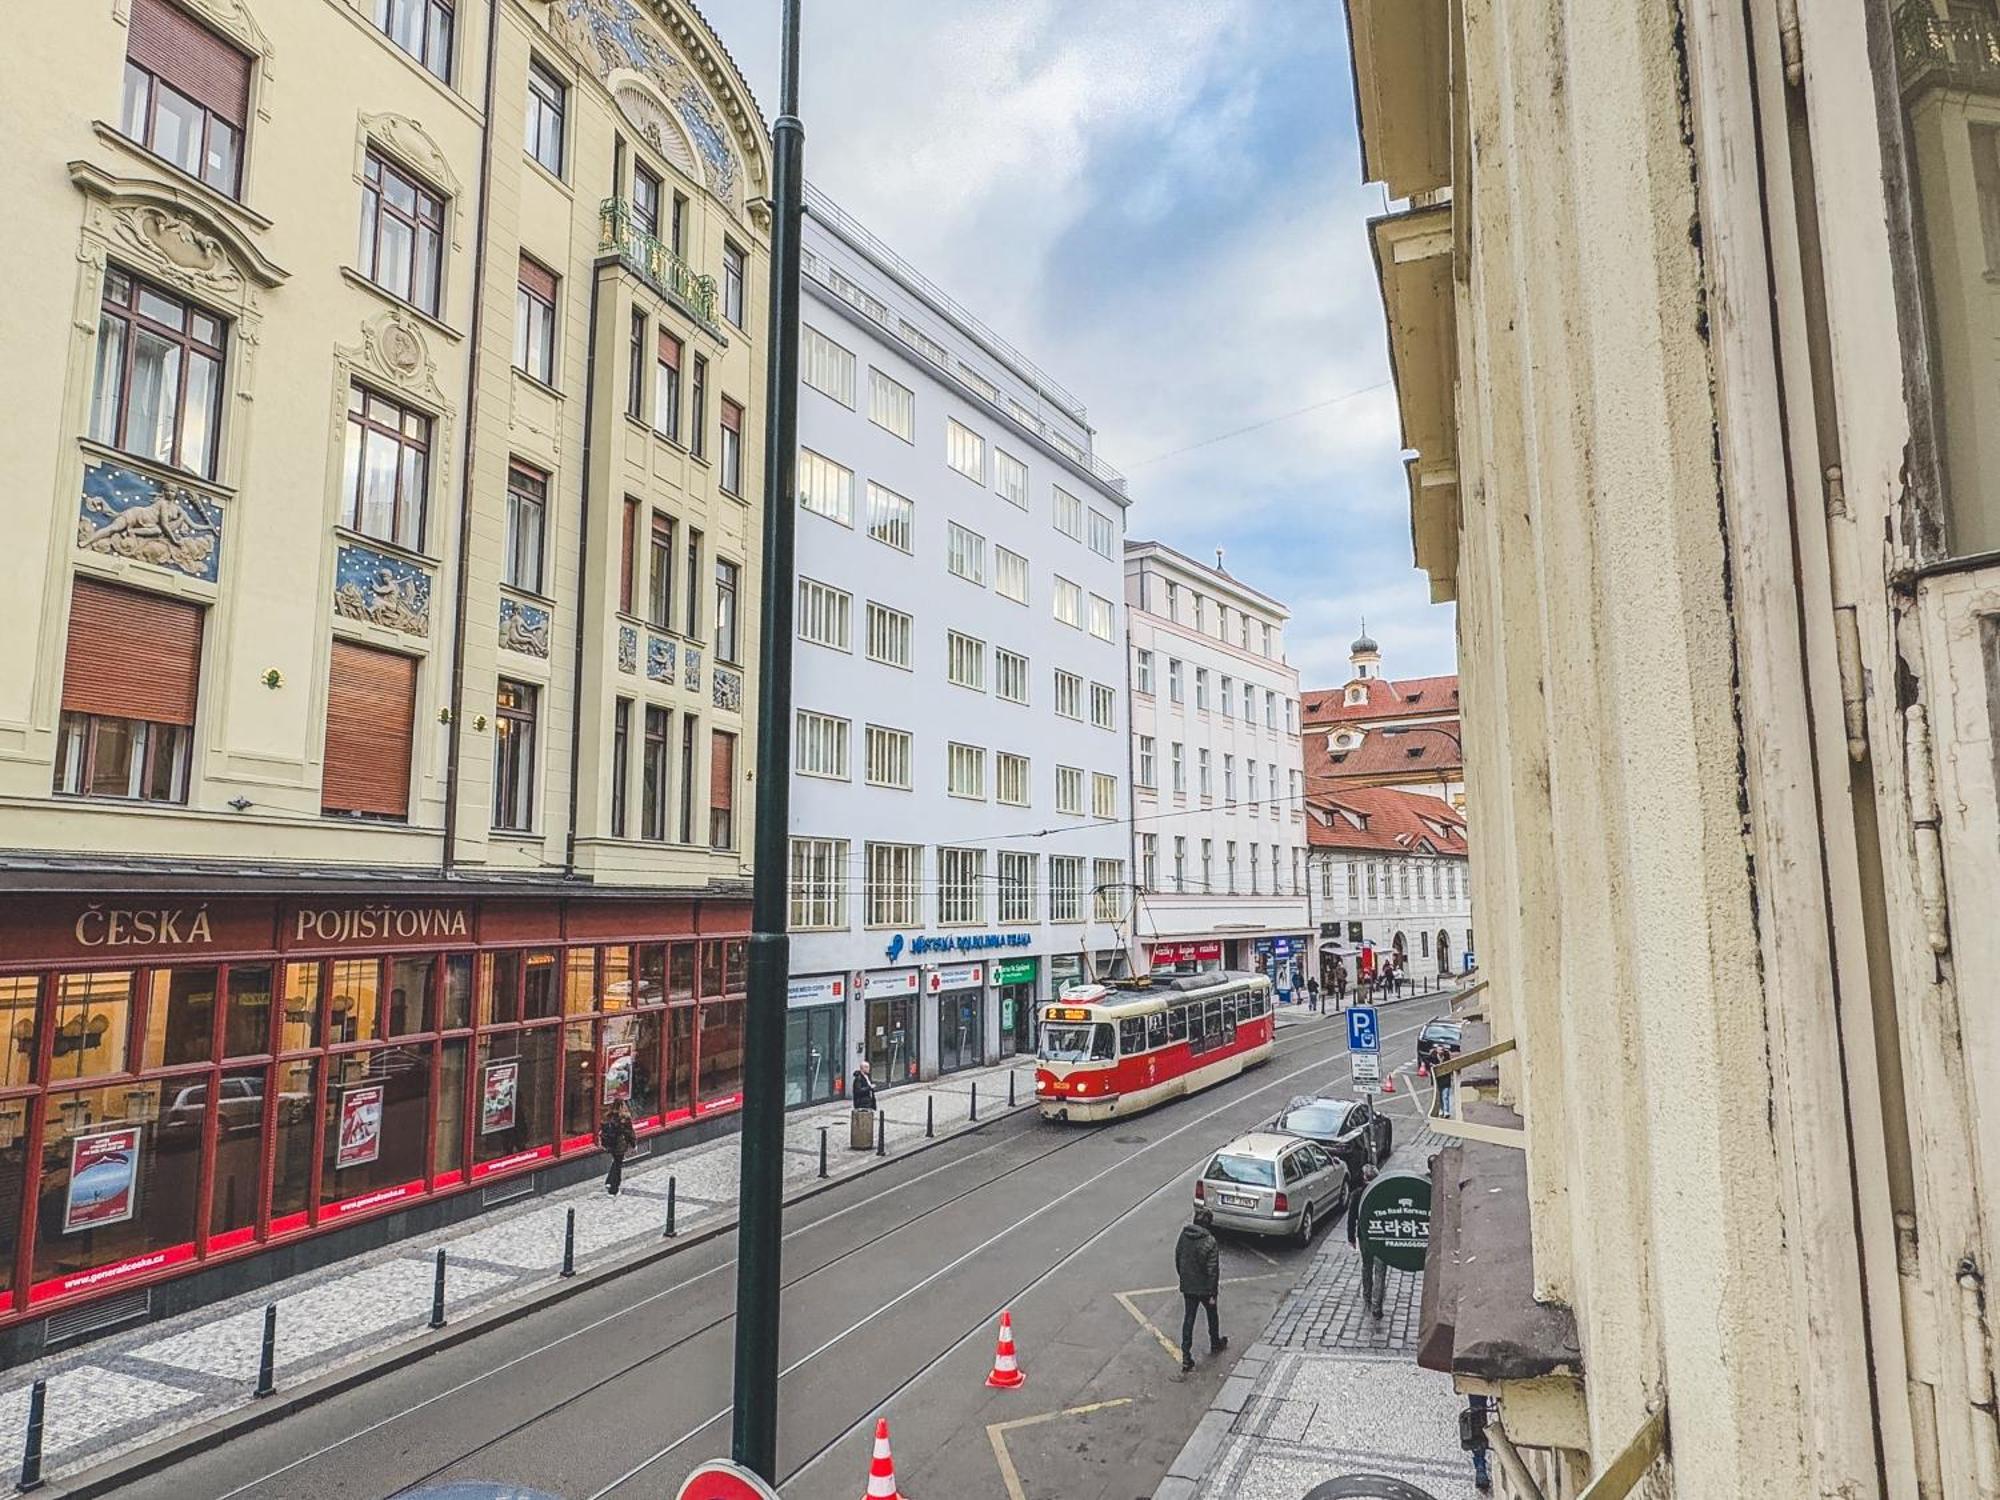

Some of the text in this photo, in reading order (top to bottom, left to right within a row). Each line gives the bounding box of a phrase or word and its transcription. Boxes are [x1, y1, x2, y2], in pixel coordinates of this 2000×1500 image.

[75, 902, 467, 946] ČESKÁ POJIŠŤOVNA
[1049, 1008, 1057, 1018] 2
[1353, 1013, 1370, 1037] P
[1403, 1208, 1427, 1216] Korean
